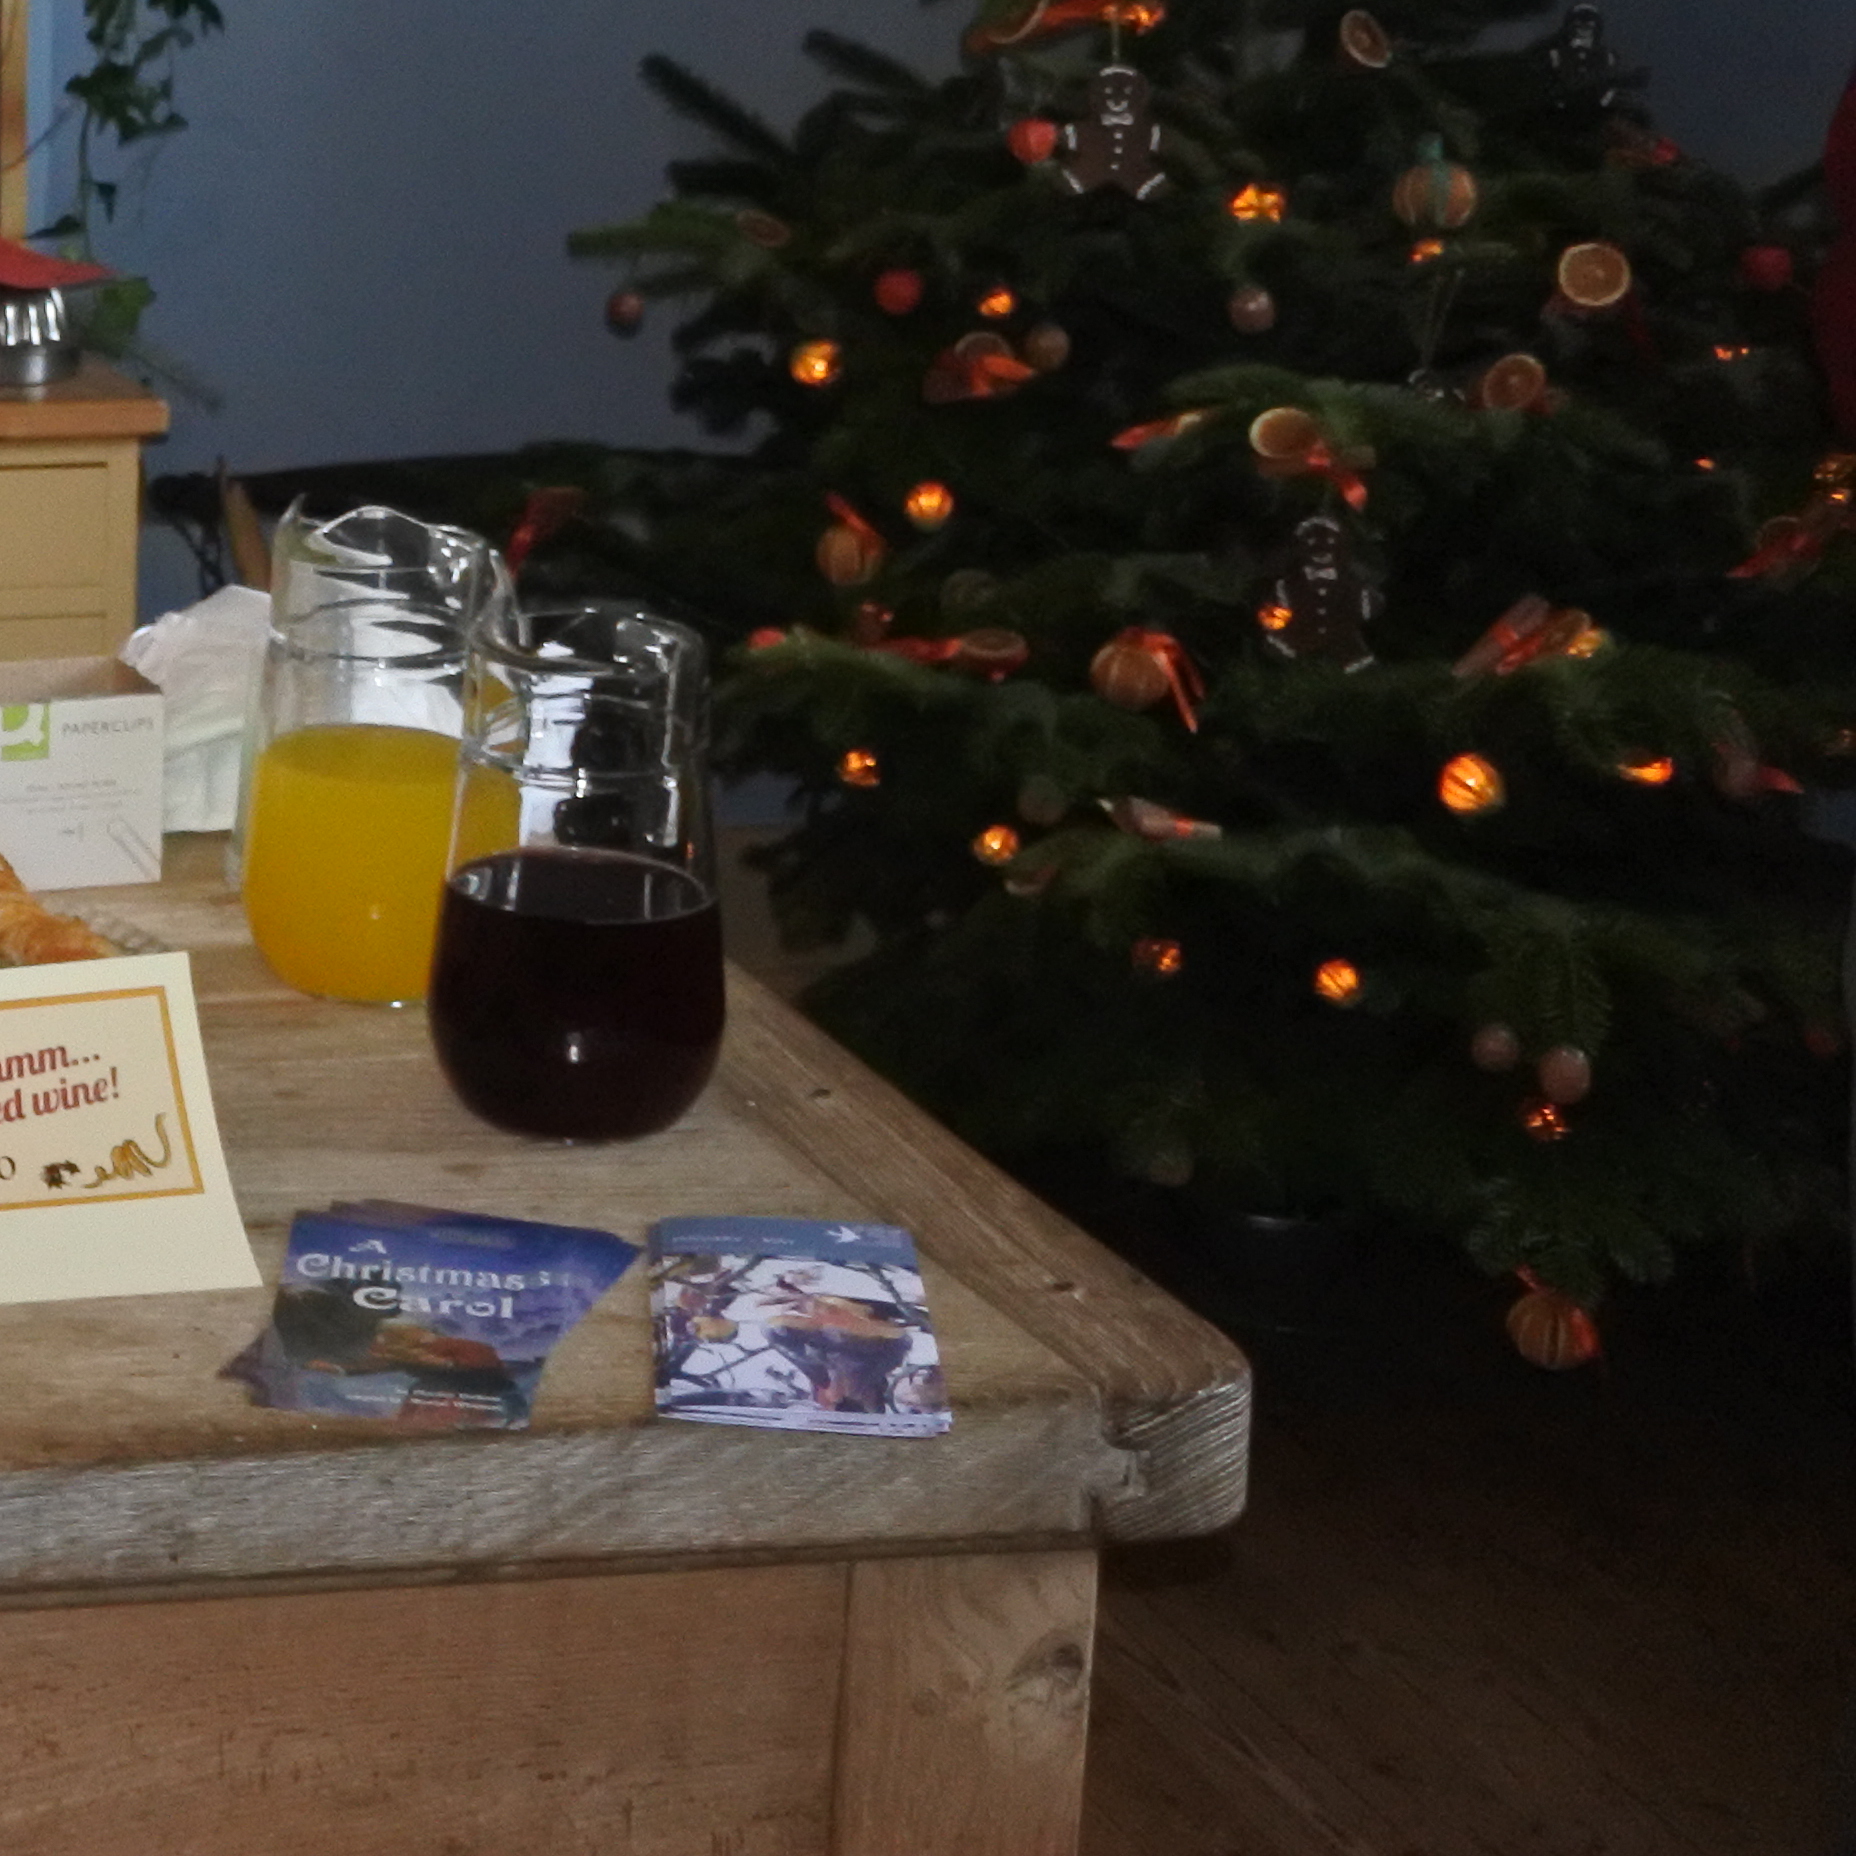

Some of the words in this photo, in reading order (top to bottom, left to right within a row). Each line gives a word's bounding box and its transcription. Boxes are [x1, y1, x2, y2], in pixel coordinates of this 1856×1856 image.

[31, 1066, 120, 1116] wine!
[348, 1239, 387, 1255] A
[296, 1252, 525, 1292] Christmas
[353, 1286, 514, 1320] Carol
